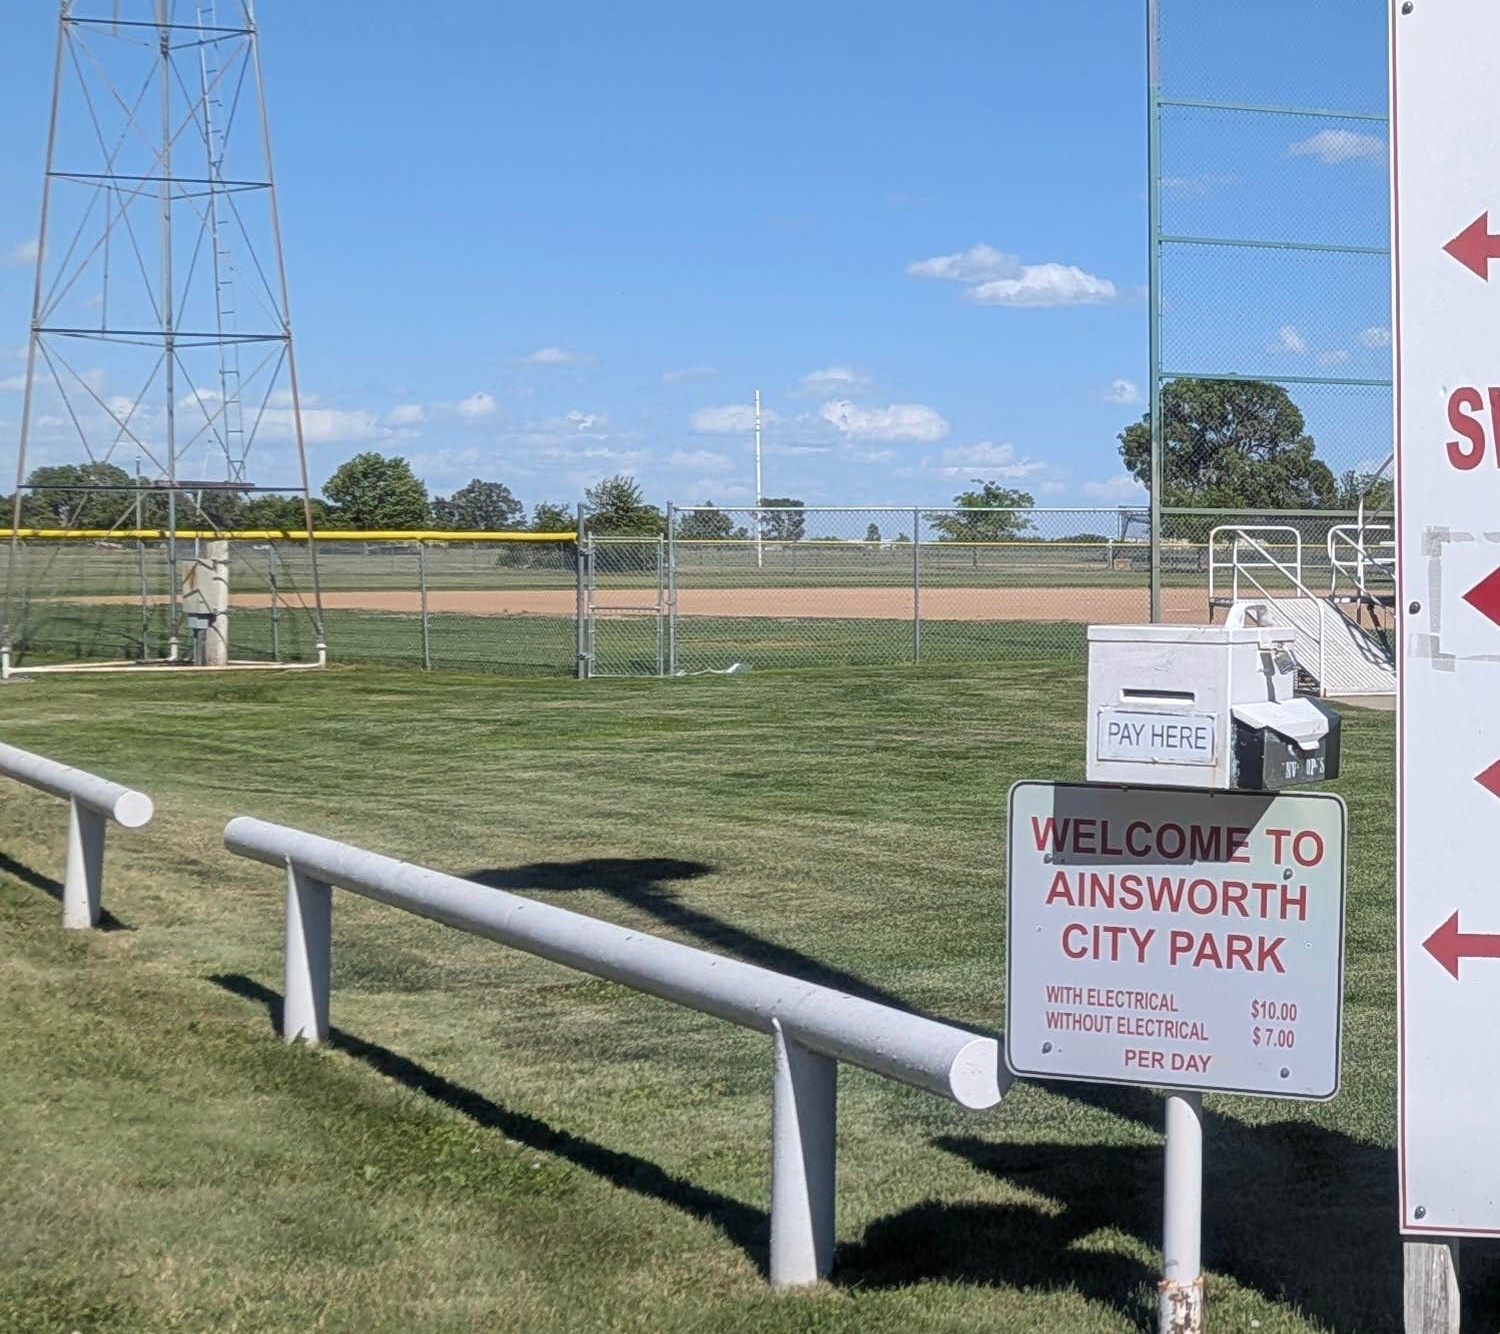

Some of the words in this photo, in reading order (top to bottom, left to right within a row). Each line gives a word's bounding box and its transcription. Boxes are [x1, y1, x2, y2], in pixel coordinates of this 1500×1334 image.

[1108, 722, 1145, 747] PAY
[1151, 723, 1207, 751] HERE
[1032, 816, 1250, 863] WELCOME
[1266, 828, 1325, 867] TO
[1045, 870, 1307, 921] AINSWORTH
[1062, 923, 1156, 964] CITY
[1169, 930, 1287, 974] PARK
[1046, 985, 1083, 1006] WITH
[1087, 988, 1179, 1013] ELECTRICAL
[1251, 999, 1298, 1022] $10.00
[1046, 1010, 1113, 1035] WITHOUT
[1117, 1017, 1209, 1041] ELECTRICAL
[1124, 1049, 1165, 1070] PER
[1171, 1052, 1212, 1073] DAY
